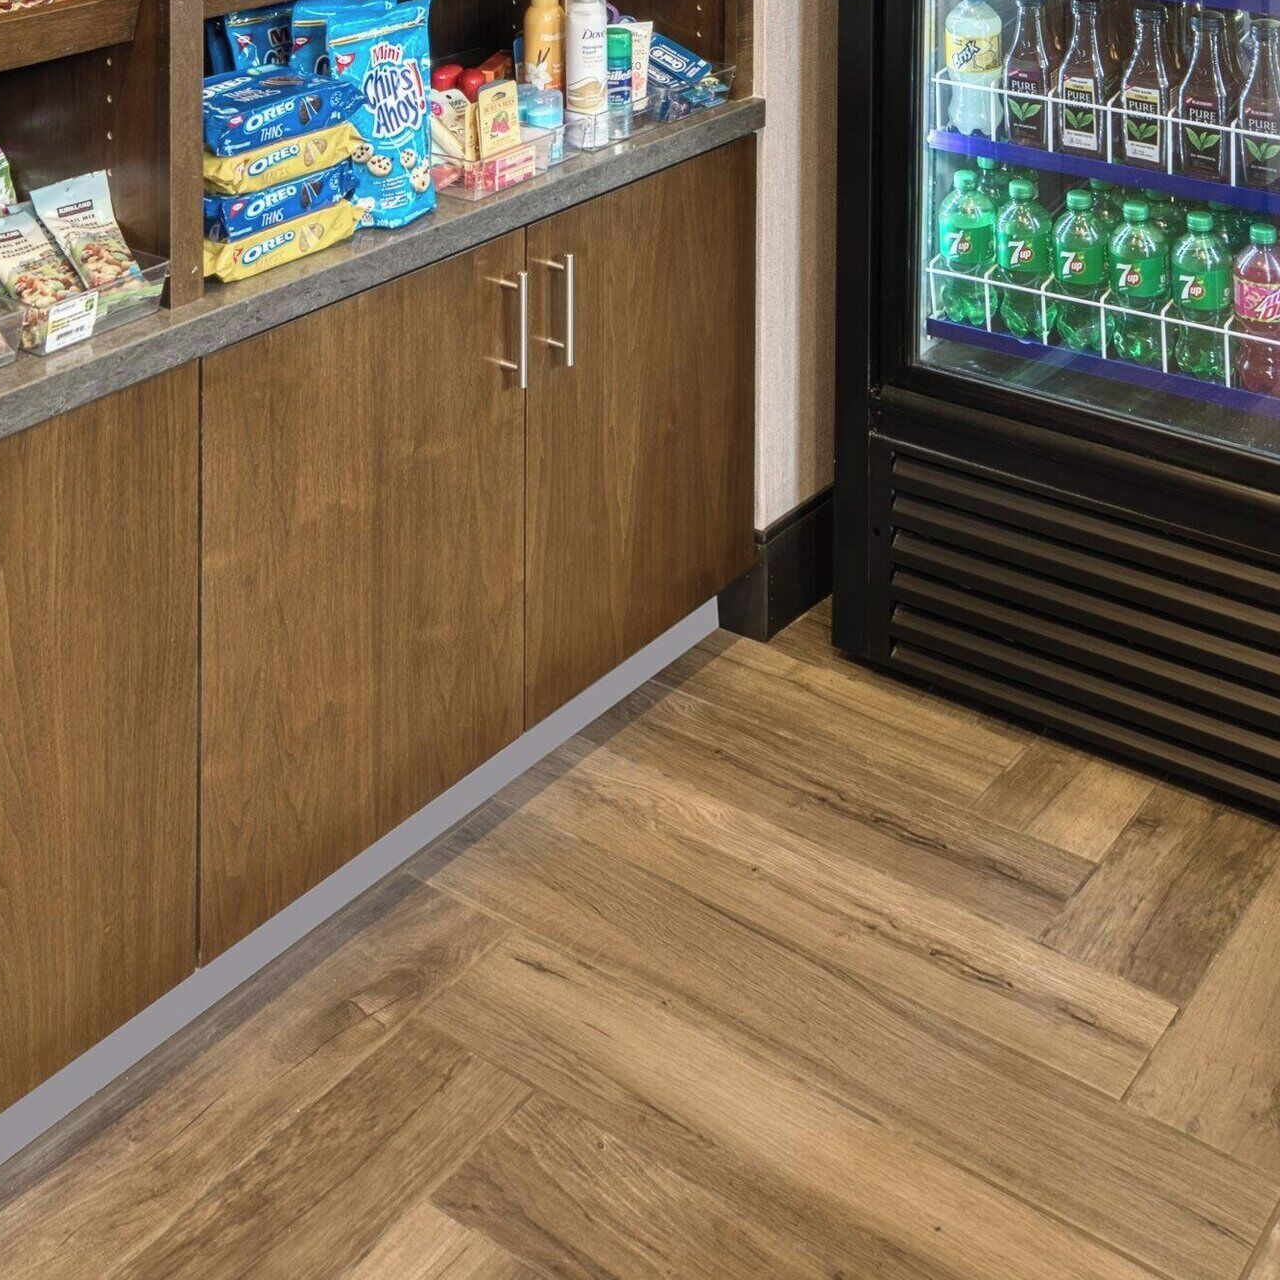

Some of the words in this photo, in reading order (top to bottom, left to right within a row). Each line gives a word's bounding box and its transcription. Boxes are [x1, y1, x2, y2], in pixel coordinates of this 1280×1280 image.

[373, 44, 400, 62] Mini
[364, 68, 412, 109] Chips
[1012, 80, 1037, 90] PURE
[1067, 90, 1091, 102] PURE
[1129, 100, 1155, 111] PURE
[245, 101, 294, 131] OREO
[1189, 108, 1216, 119] PURE
[1248, 119, 1277, 130] PURE
[248, 145, 299, 175] OREO
[60, 201, 92, 214] KIRKLAND
[247, 186, 297, 218] OREO
[243, 231, 294, 264] OREO
